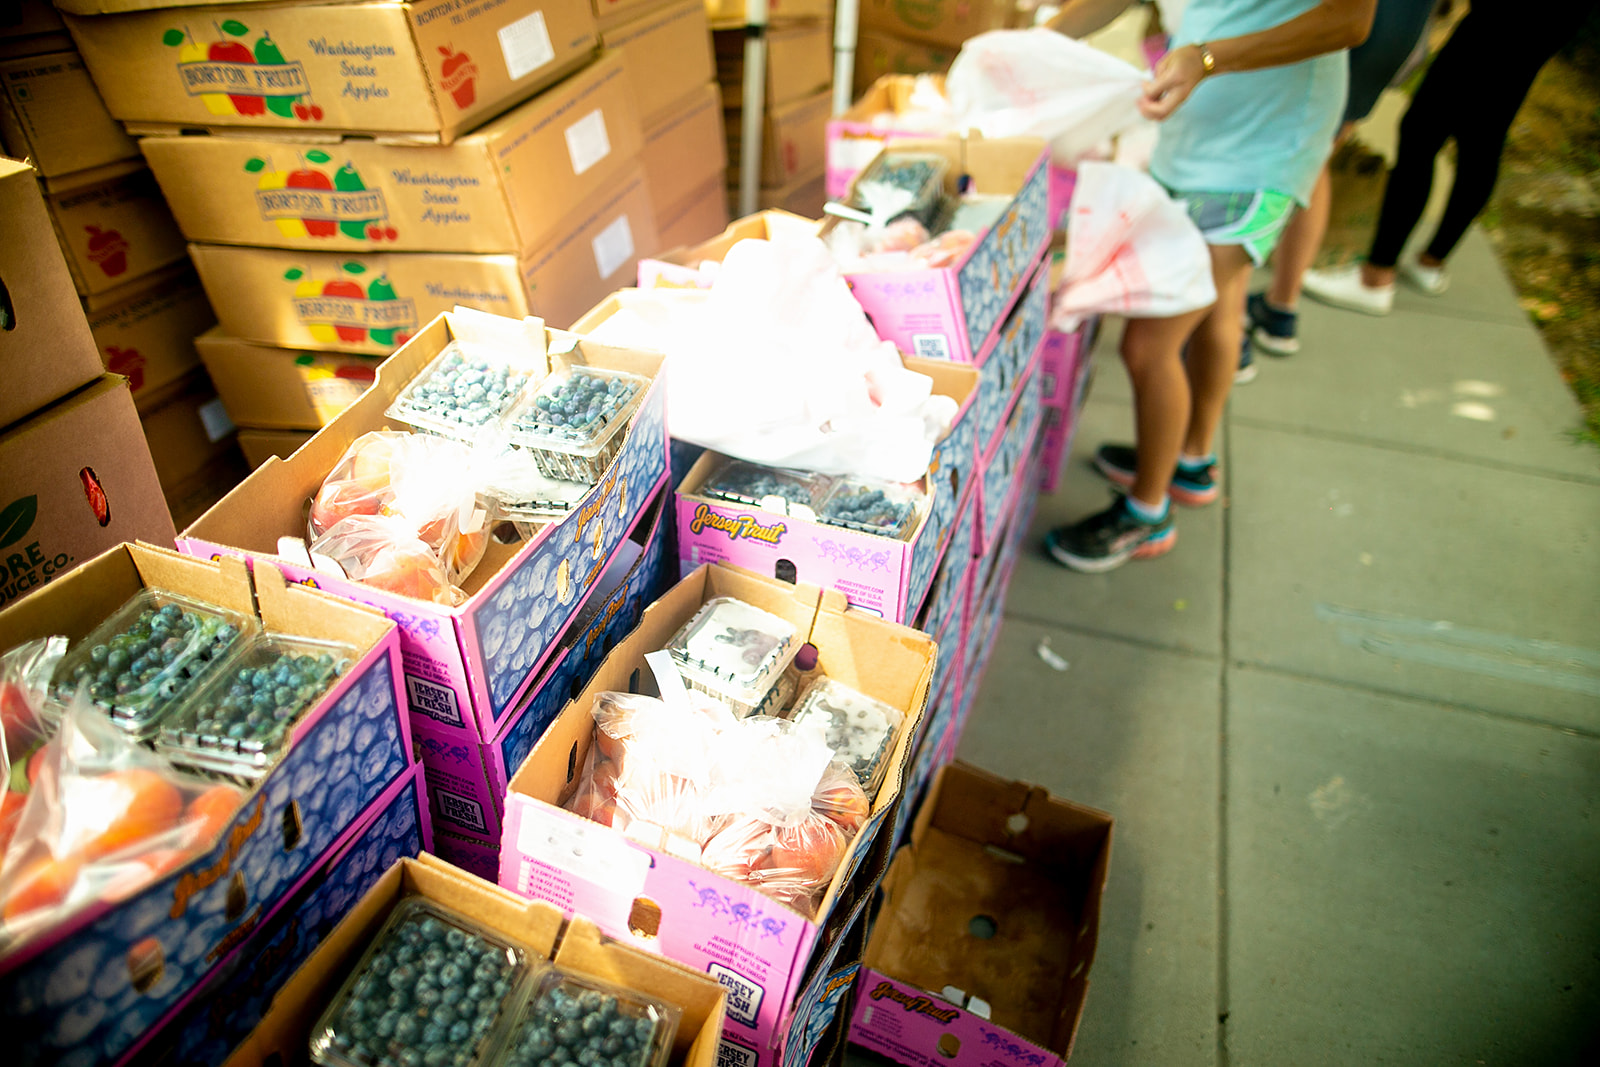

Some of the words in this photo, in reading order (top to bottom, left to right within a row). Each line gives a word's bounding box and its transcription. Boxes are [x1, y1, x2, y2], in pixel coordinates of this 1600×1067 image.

[308, 37, 395, 60] Washington
[183, 64, 248, 87] BORTON
[253, 65, 302, 89] FRUIT
[340, 60, 377, 78] State
[341, 80, 389, 102] Apples
[391, 167, 480, 188] Washington
[261, 194, 325, 214] BORTON
[329, 195, 382, 215] FRUIT
[422, 189, 458, 205] State
[420, 209, 471, 226] Apples
[414, 681, 449, 702] JERSEY
[417, 694, 453, 715] FRESH
[719, 1043, 750, 1063] ERSEY
